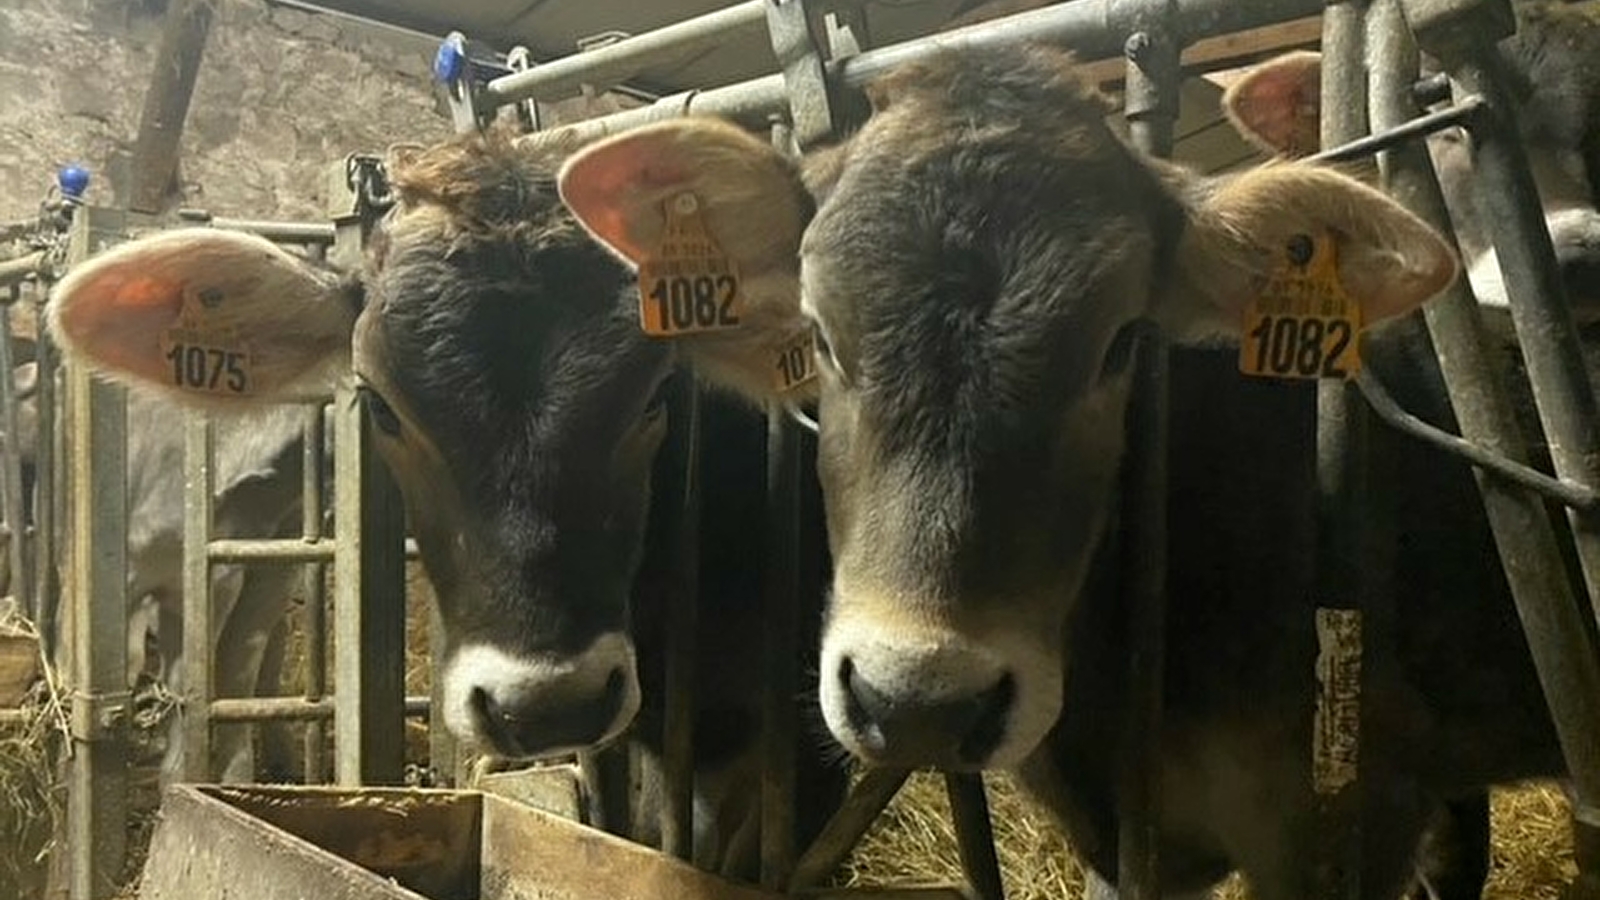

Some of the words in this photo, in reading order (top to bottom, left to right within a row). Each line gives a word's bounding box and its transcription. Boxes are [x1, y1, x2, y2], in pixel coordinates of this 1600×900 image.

[650, 275, 739, 331] 1082
[167, 343, 247, 392] 1075
[1251, 315, 1351, 379] 1082
